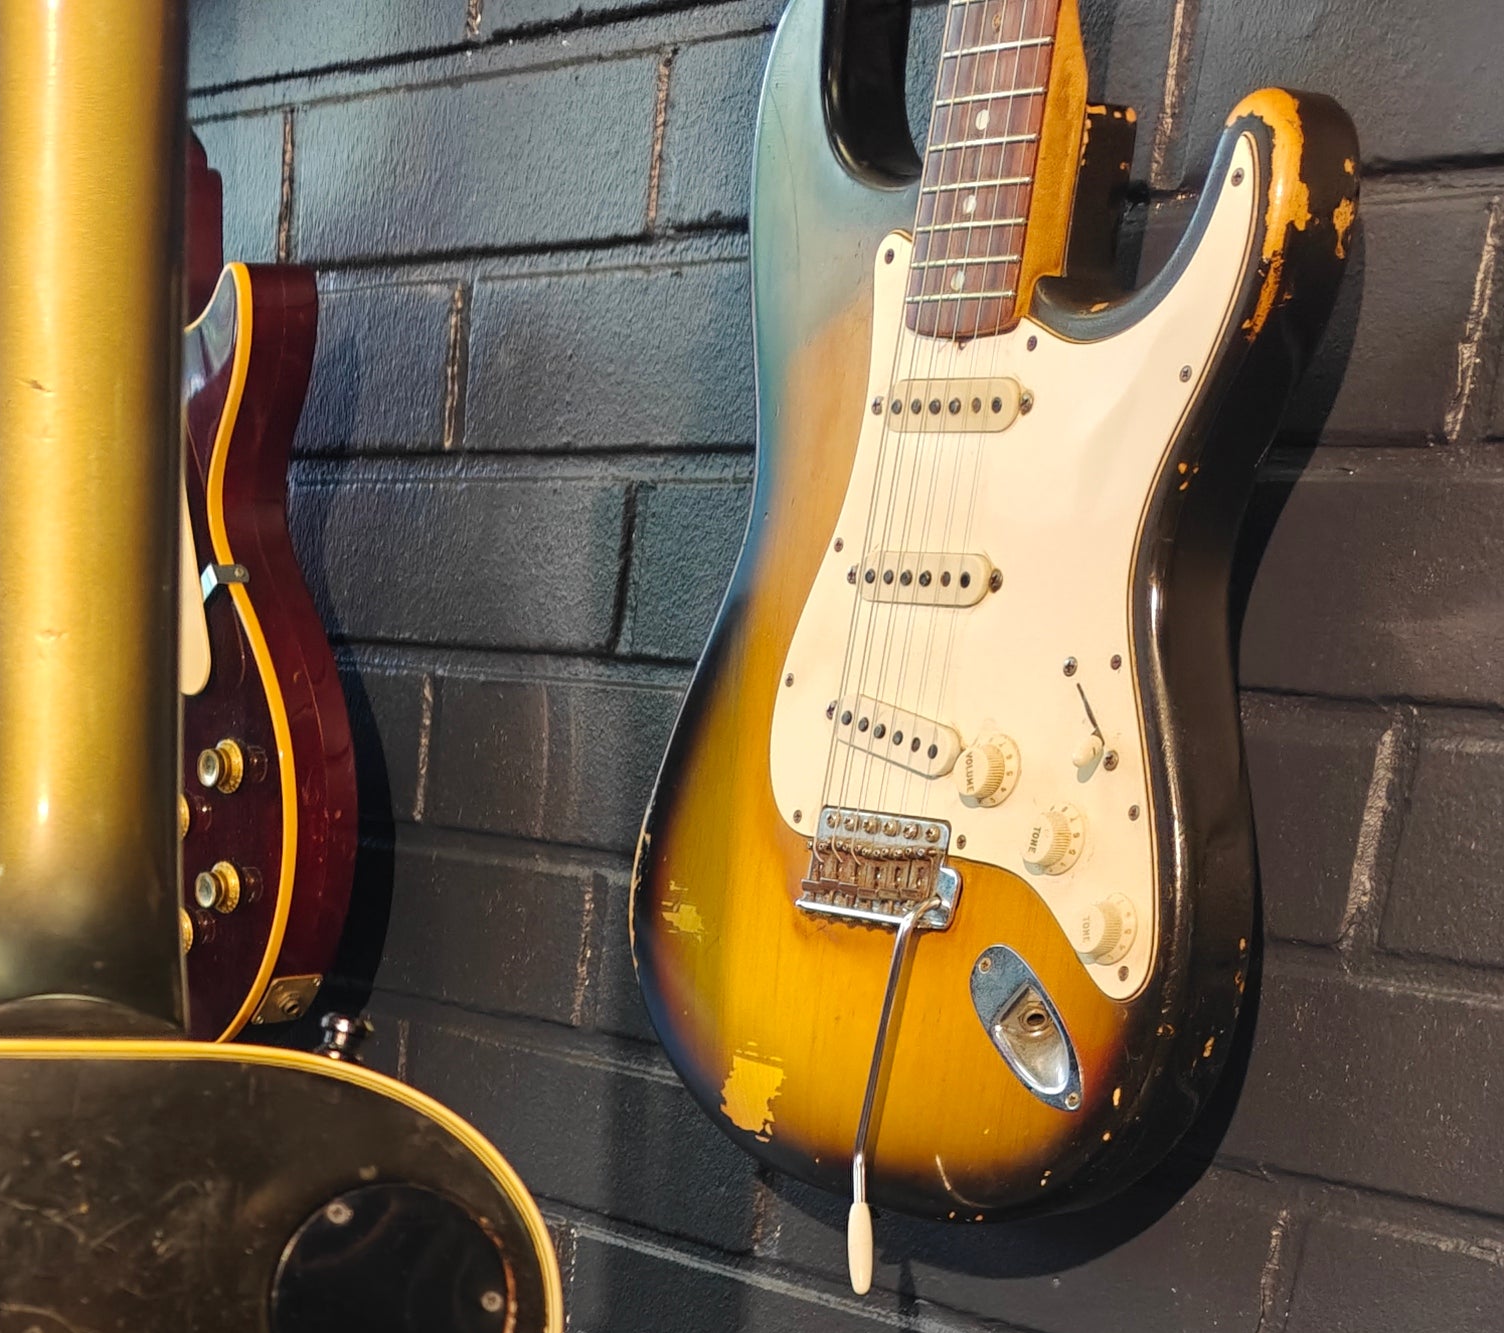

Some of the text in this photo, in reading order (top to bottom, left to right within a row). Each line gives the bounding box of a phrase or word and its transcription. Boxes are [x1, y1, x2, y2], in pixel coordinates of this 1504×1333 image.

[965, 750, 975, 793] VOLUME
[1028, 826, 1042, 854] TONE
[1082, 915, 1091, 944] TONE
